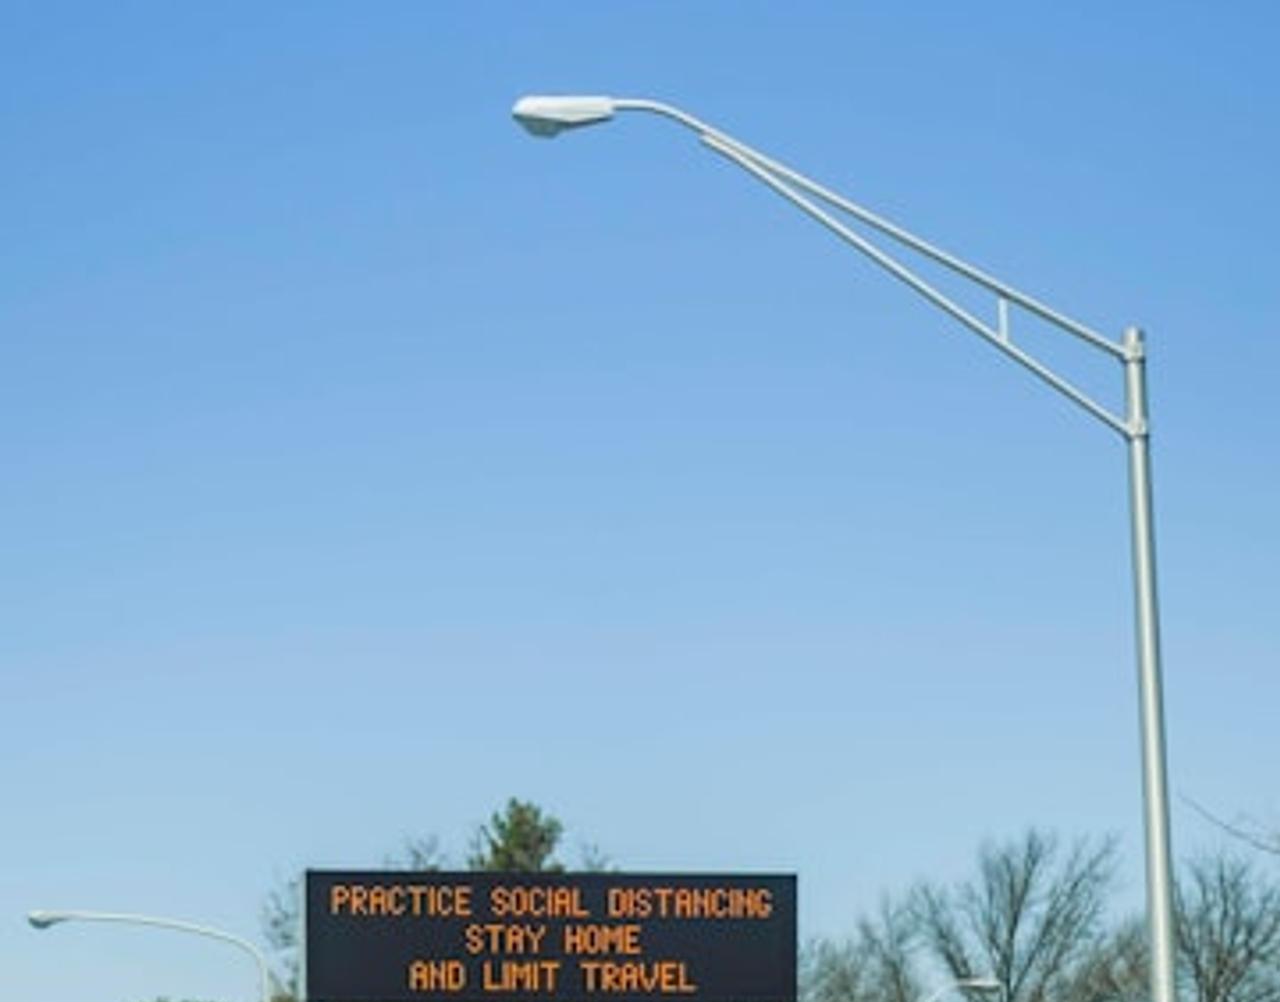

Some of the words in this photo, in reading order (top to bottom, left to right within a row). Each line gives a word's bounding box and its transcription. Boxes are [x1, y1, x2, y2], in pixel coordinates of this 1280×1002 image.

[331, 886, 471, 917] PRACTICE
[491, 887, 589, 918] SOCIAL
[608, 888, 773, 918] DISTANCING
[466, 923, 547, 954] STAY
[564, 924, 641, 954] HOME
[409, 960, 466, 992] AND
[483, 960, 560, 992] LIMIT
[581, 960, 696, 992] TRAVEL
